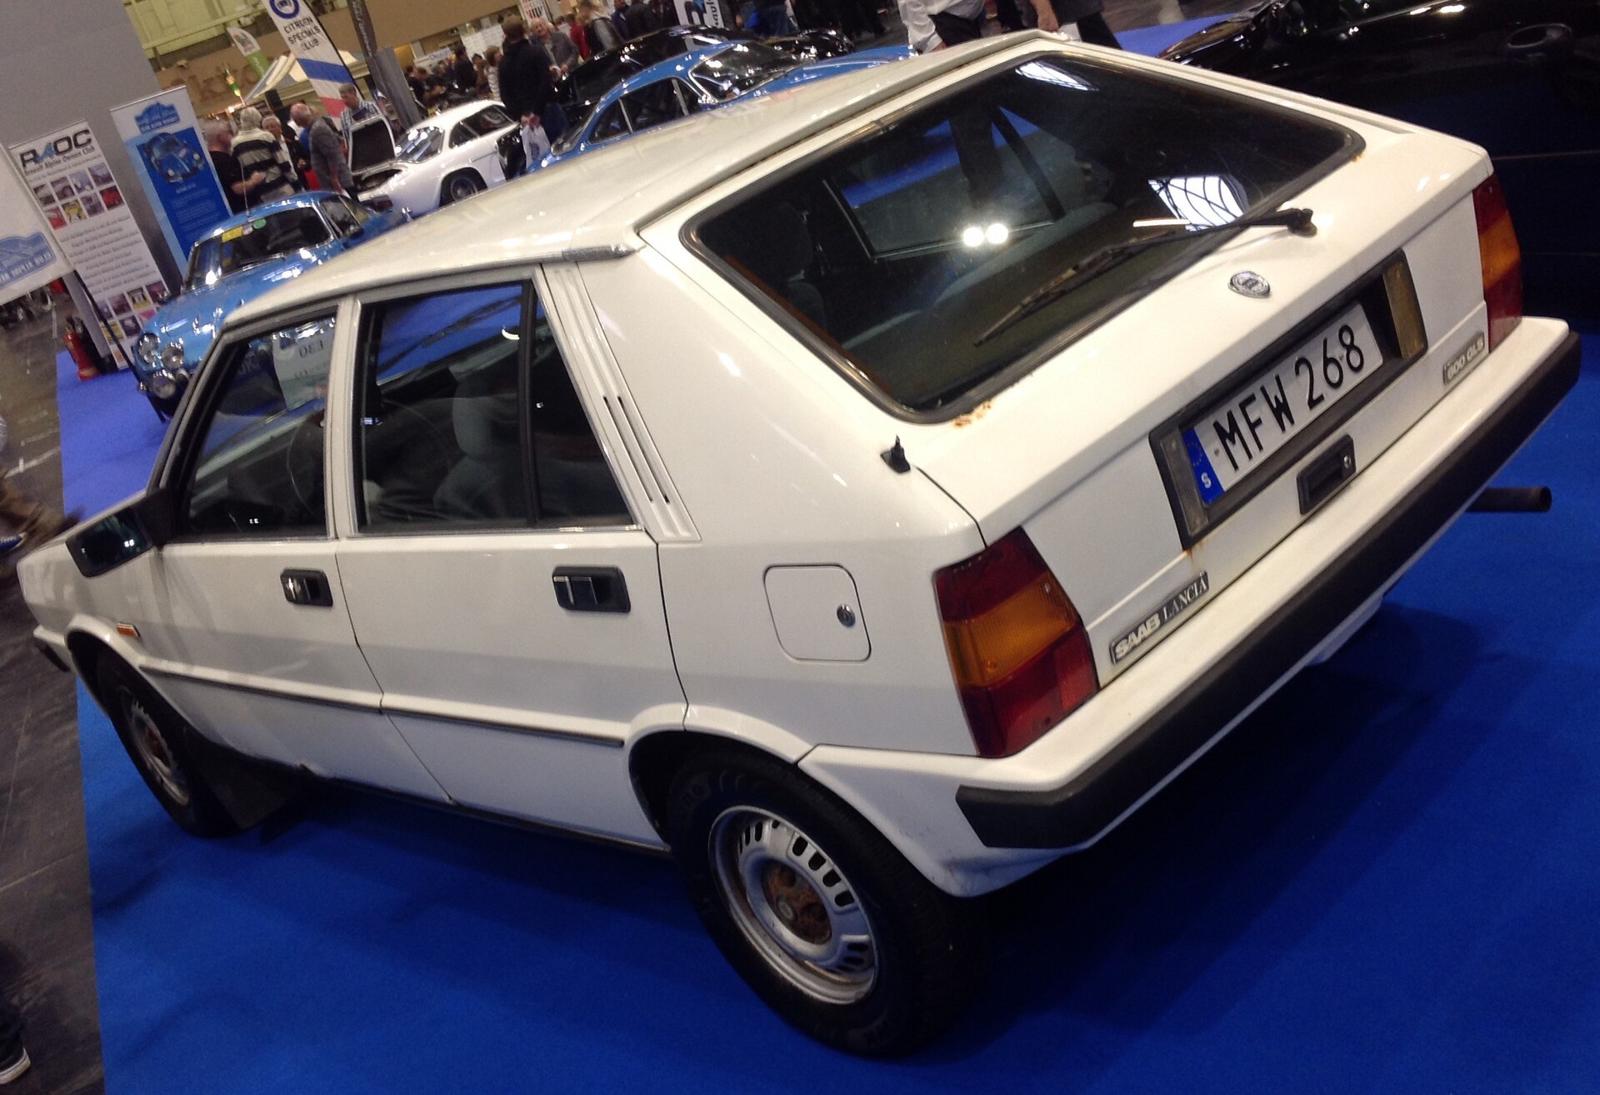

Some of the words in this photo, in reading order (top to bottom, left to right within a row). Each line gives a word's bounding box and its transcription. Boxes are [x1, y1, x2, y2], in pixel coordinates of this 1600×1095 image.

[1466, 337, 1485, 362] GLS
[1212, 374, 1295, 471] MFW
[1294, 324, 1364, 411] 268
[1201, 472, 1212, 489] S
[1114, 612, 1161, 659] SAAB
[1162, 575, 1207, 621] LANCIA
